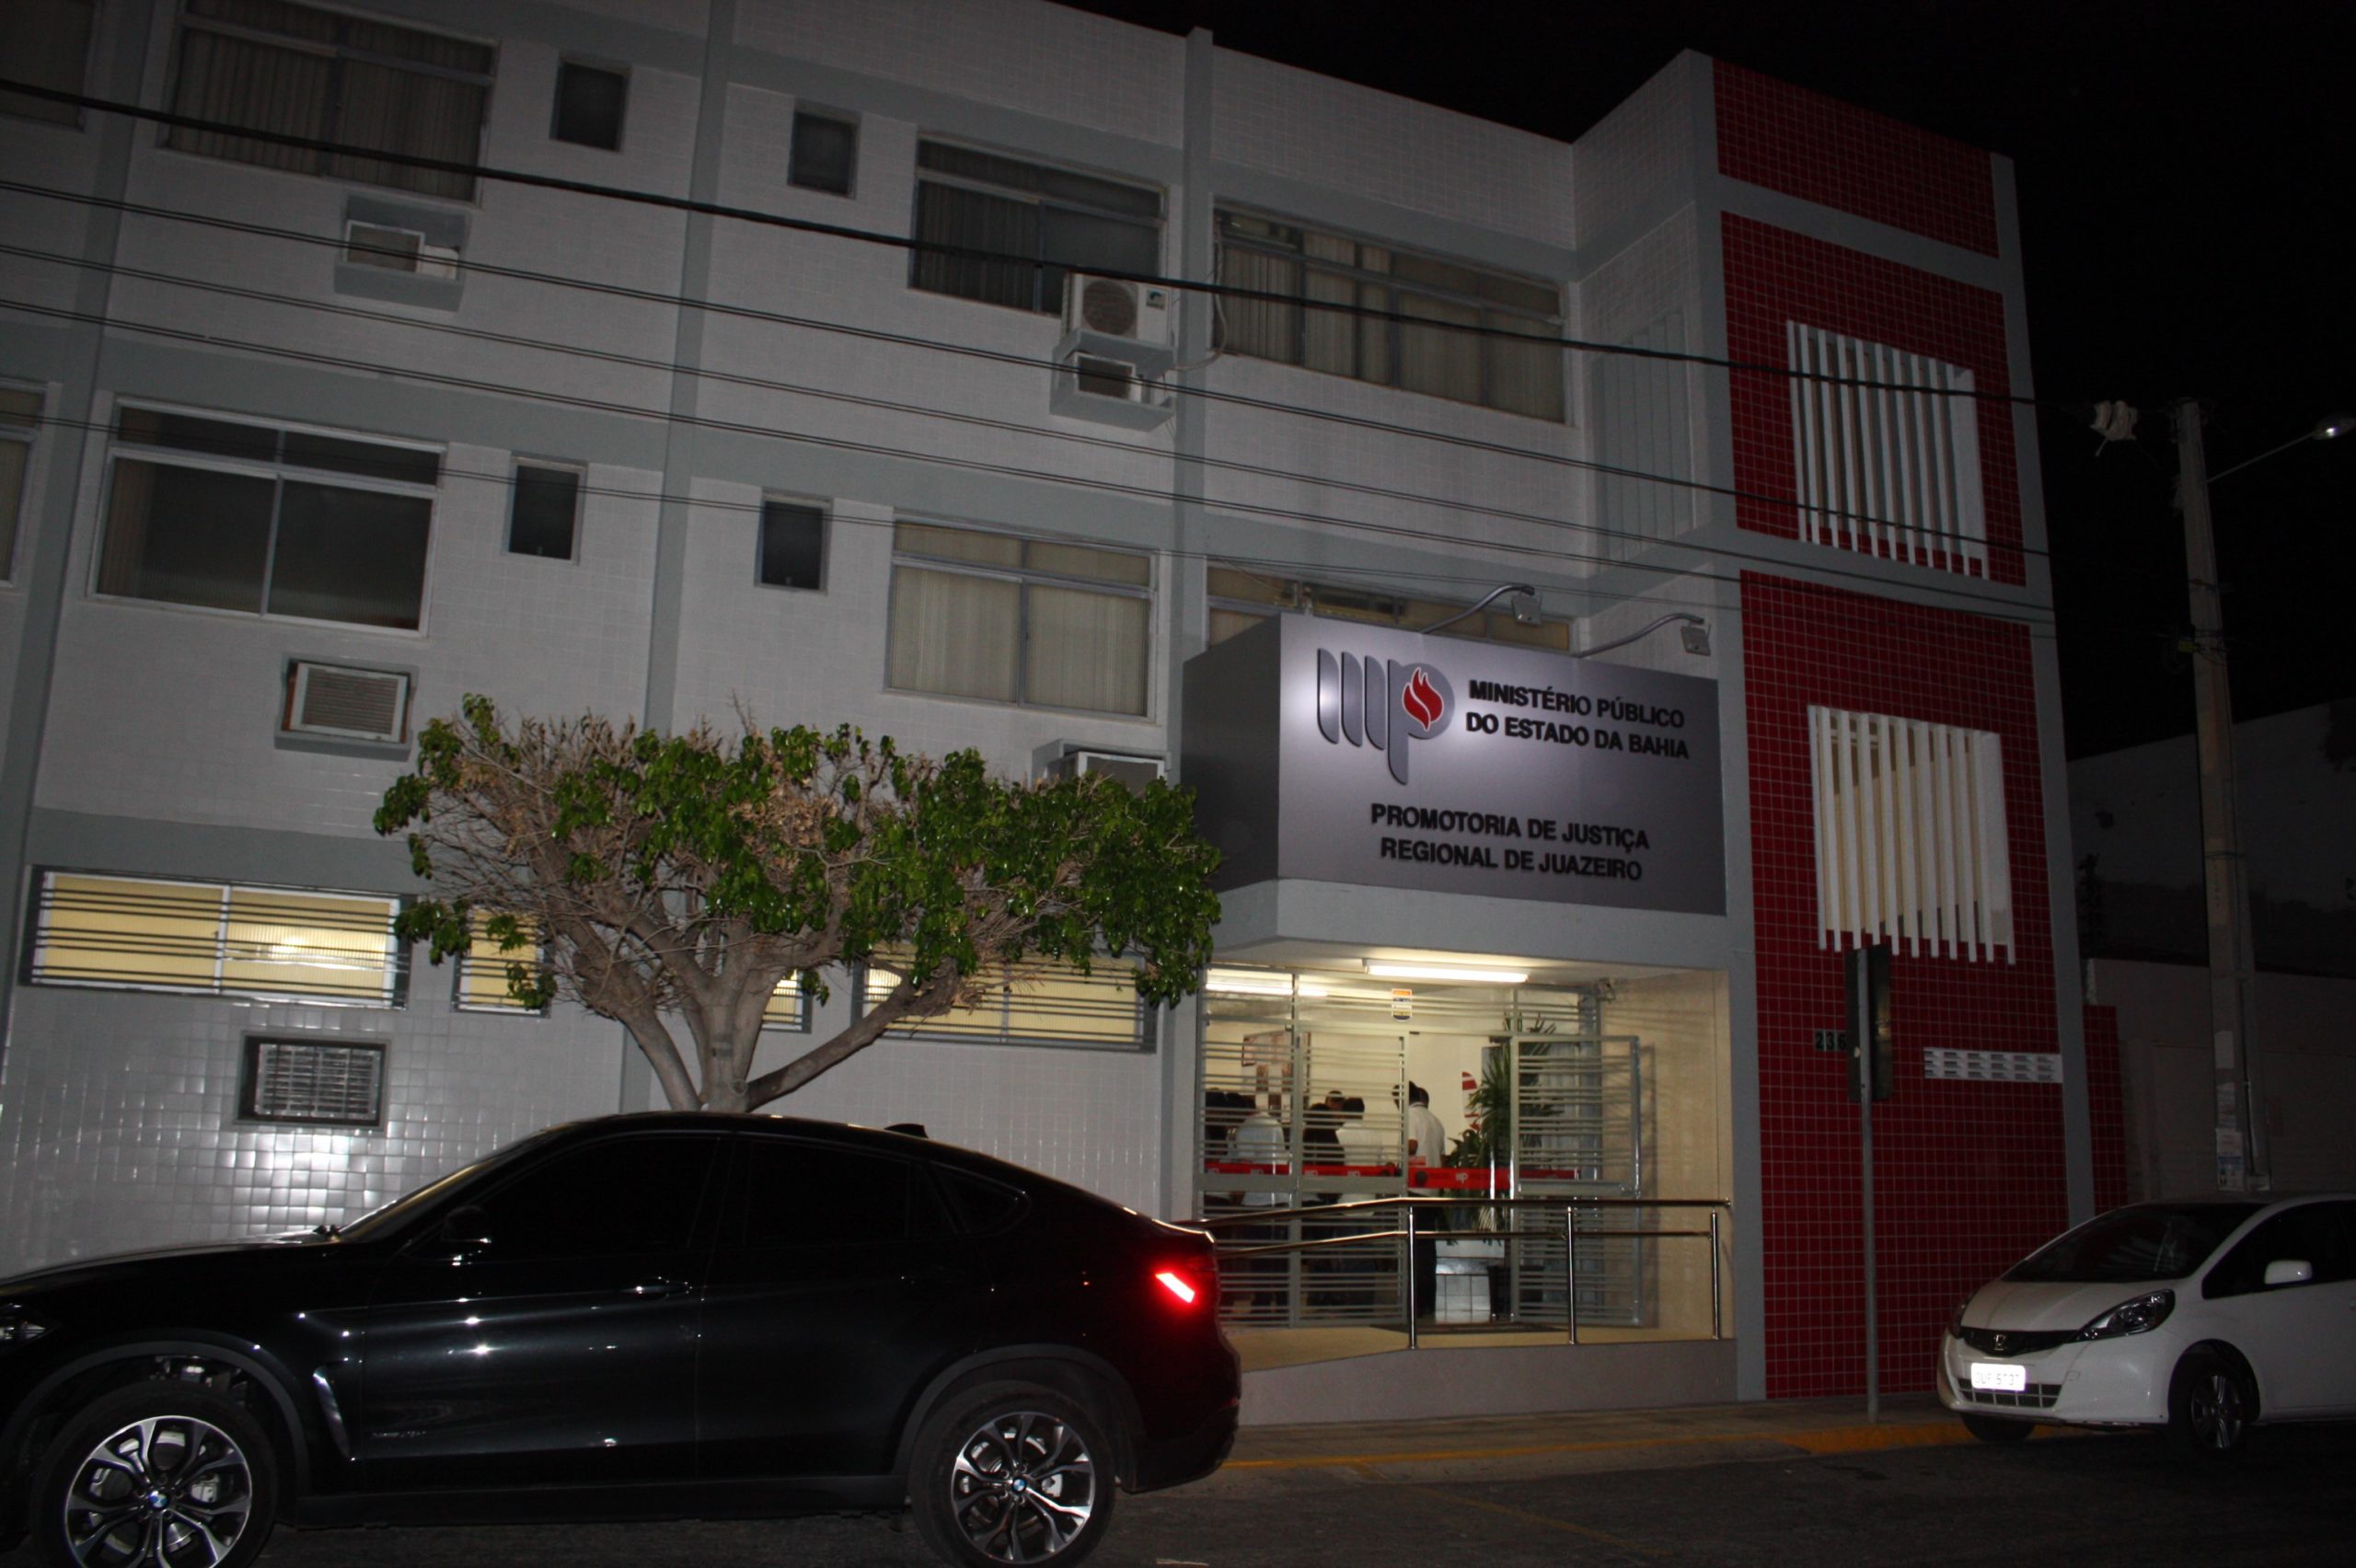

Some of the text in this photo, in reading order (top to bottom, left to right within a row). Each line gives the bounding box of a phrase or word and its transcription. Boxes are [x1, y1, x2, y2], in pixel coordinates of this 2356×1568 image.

[1469, 679, 1684, 729] MINISTÉRIO PÚBLICO
[1466, 711, 1690, 759] DO ESTADO DA BAHIA
[1371, 802, 1650, 853] PROMOTORIA DE JUSTIÇA
[1380, 836, 1643, 881] REGIONAL DE JUAZEIRO
[1816, 1032, 1847, 1050] 236
